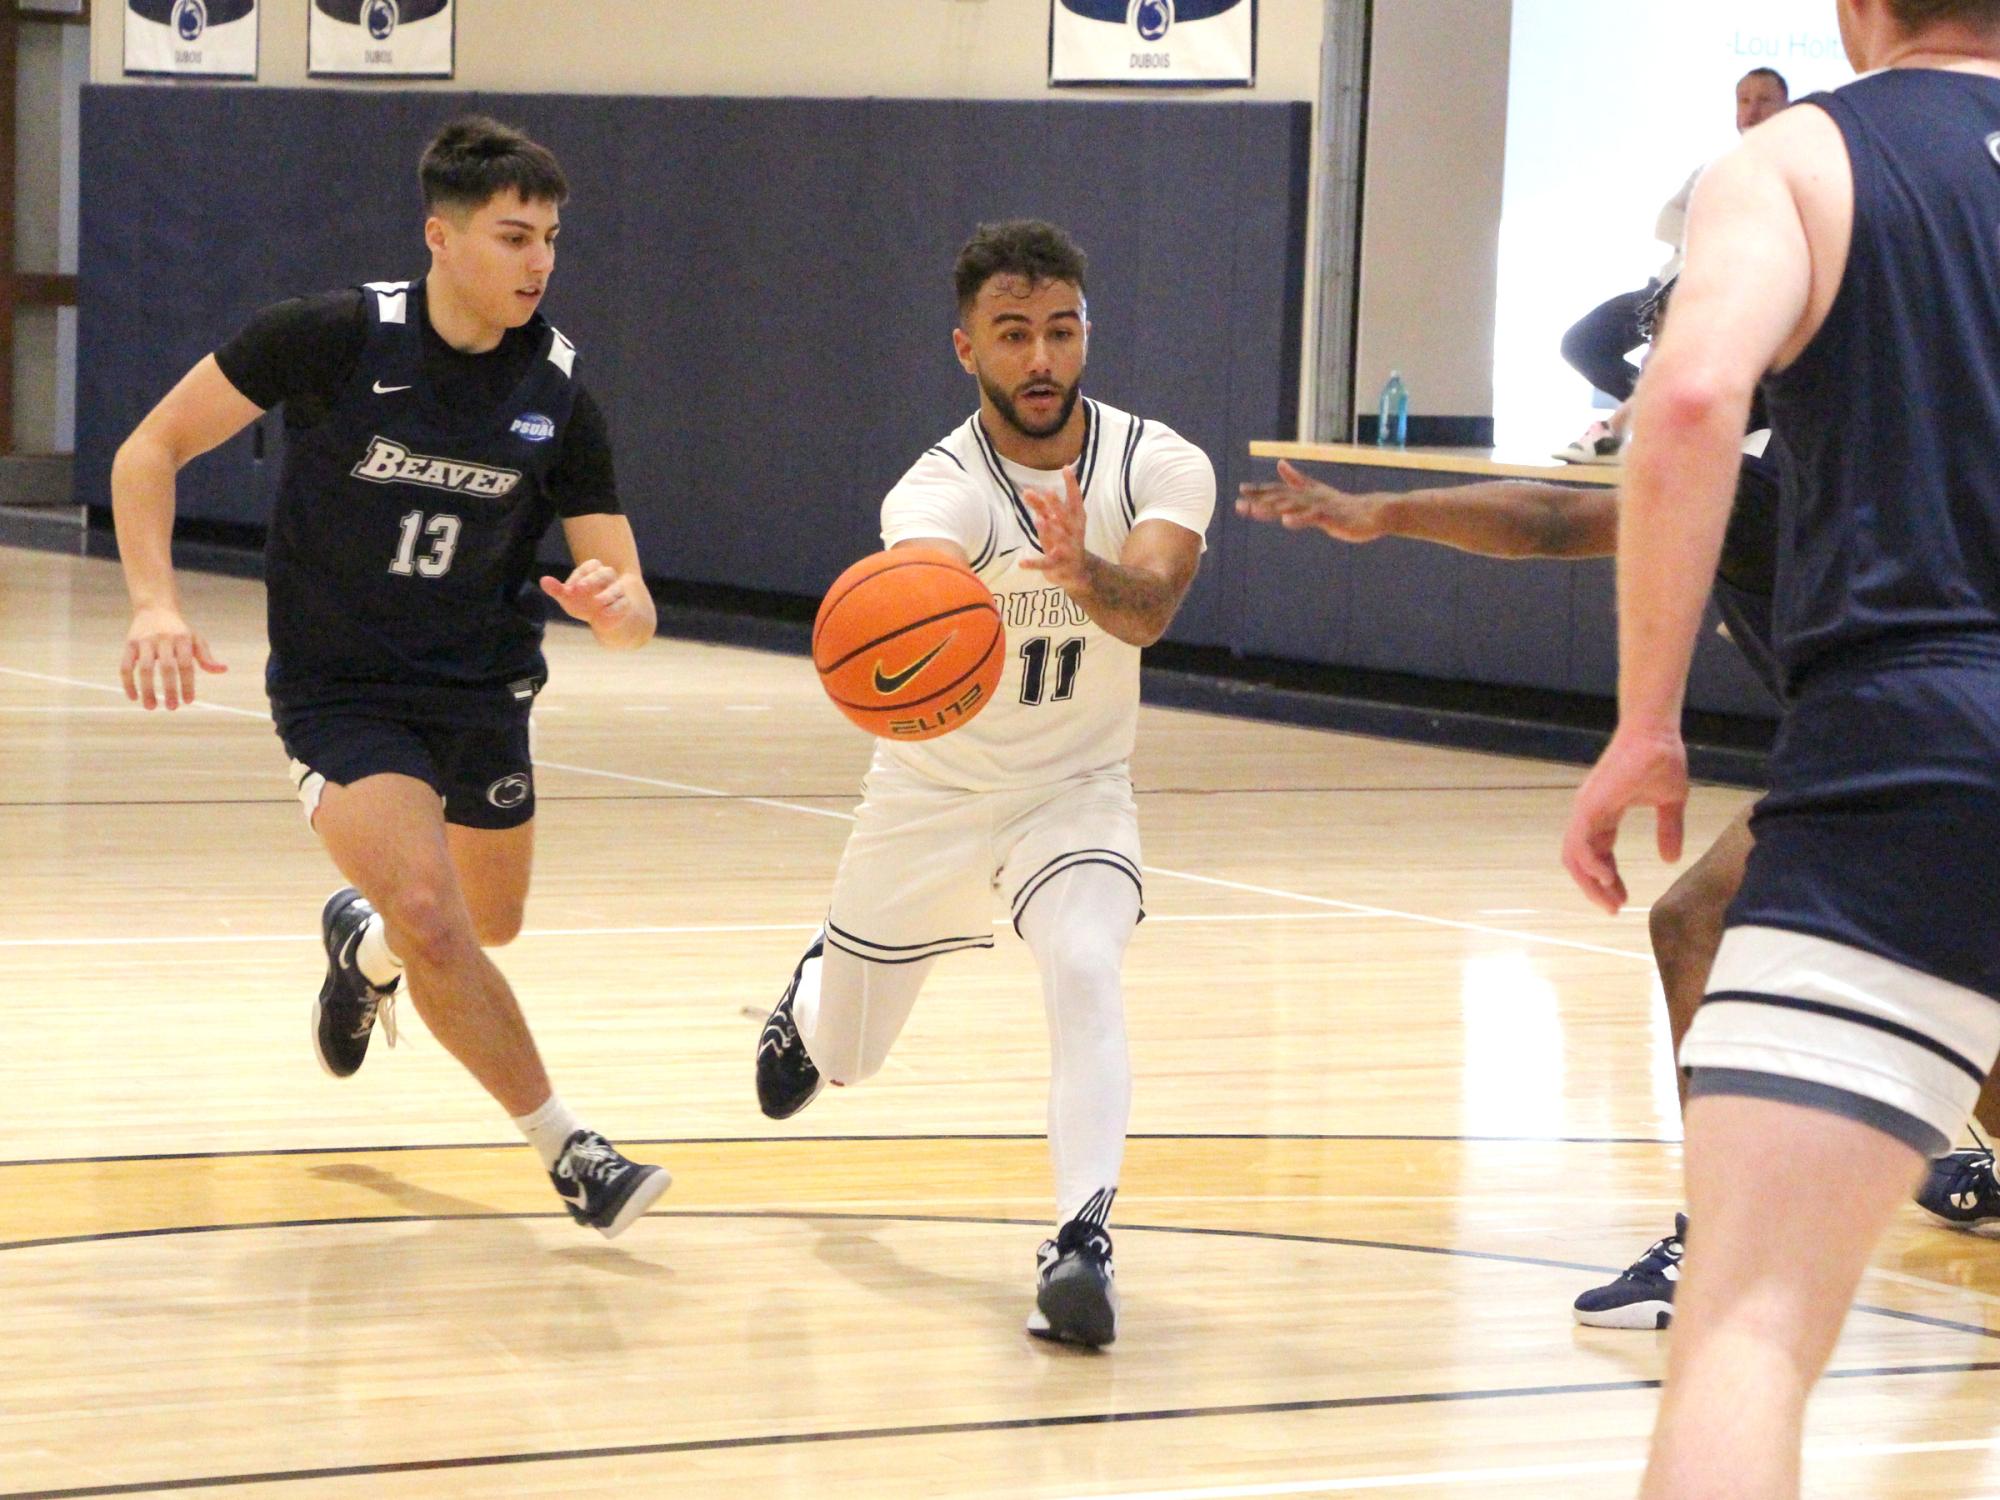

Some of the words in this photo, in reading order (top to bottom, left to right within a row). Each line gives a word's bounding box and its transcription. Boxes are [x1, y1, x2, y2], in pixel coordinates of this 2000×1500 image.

[1130, 53, 1170, 68] DUBOIS
[1788, 31, 1846, 59] Holt
[353, 437, 521, 497] BEAVER
[389, 510, 462, 577] 13
[1019, 636, 1085, 706] 11
[889, 683, 983, 735] ELITE
